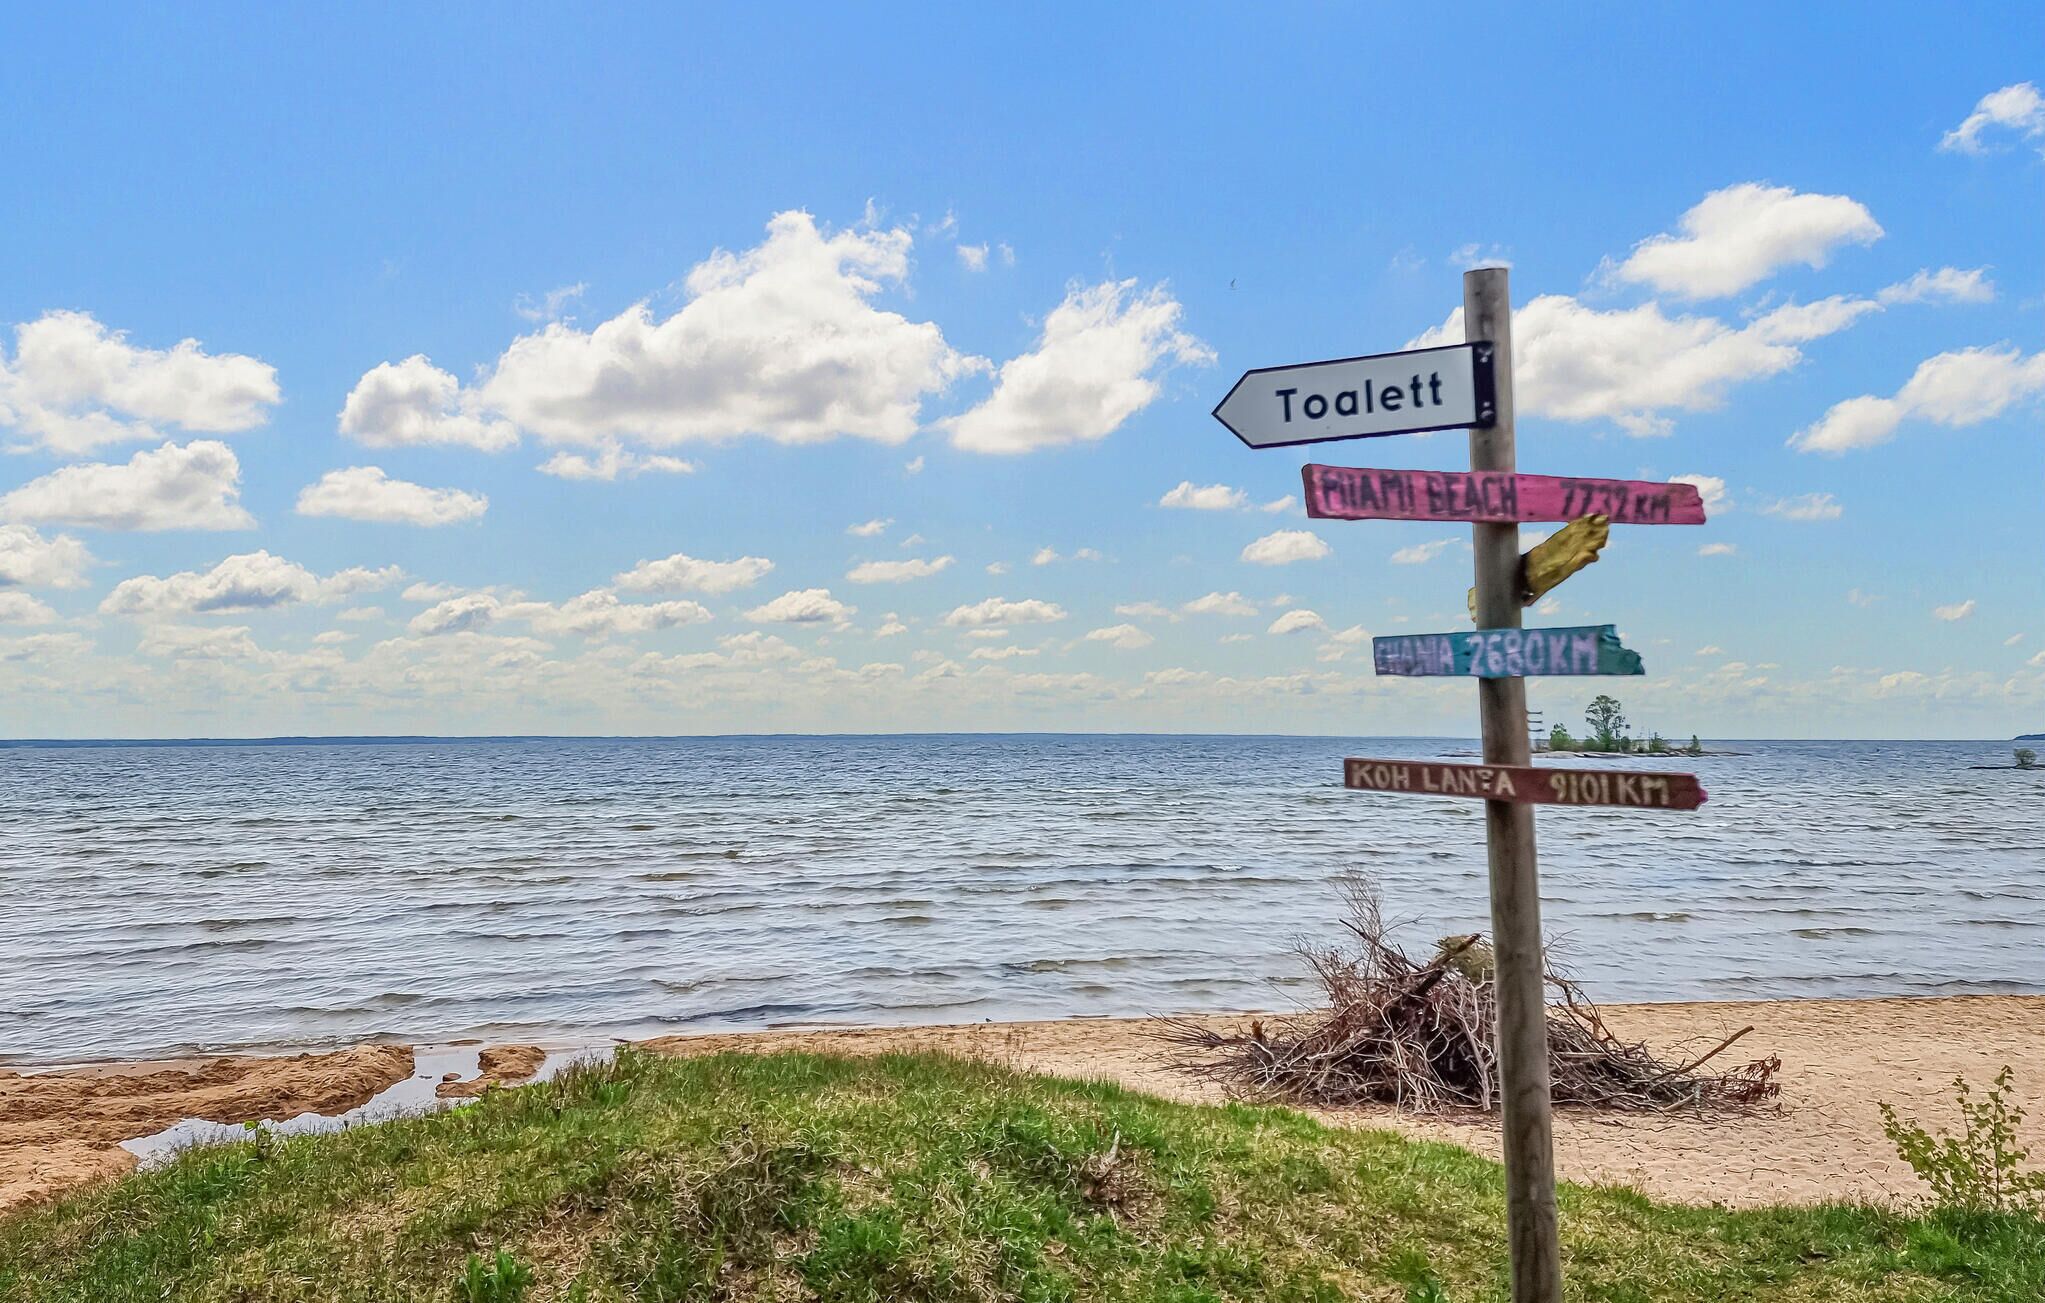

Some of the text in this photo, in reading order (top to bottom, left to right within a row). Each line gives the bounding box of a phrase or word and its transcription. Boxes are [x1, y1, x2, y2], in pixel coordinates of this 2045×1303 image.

[1275, 371, 1443, 423] Toalett
[1320, 469, 1416, 514] MIAMI
[1426, 475, 1518, 517] BEACH
[1351, 763, 1410, 790] KOH
